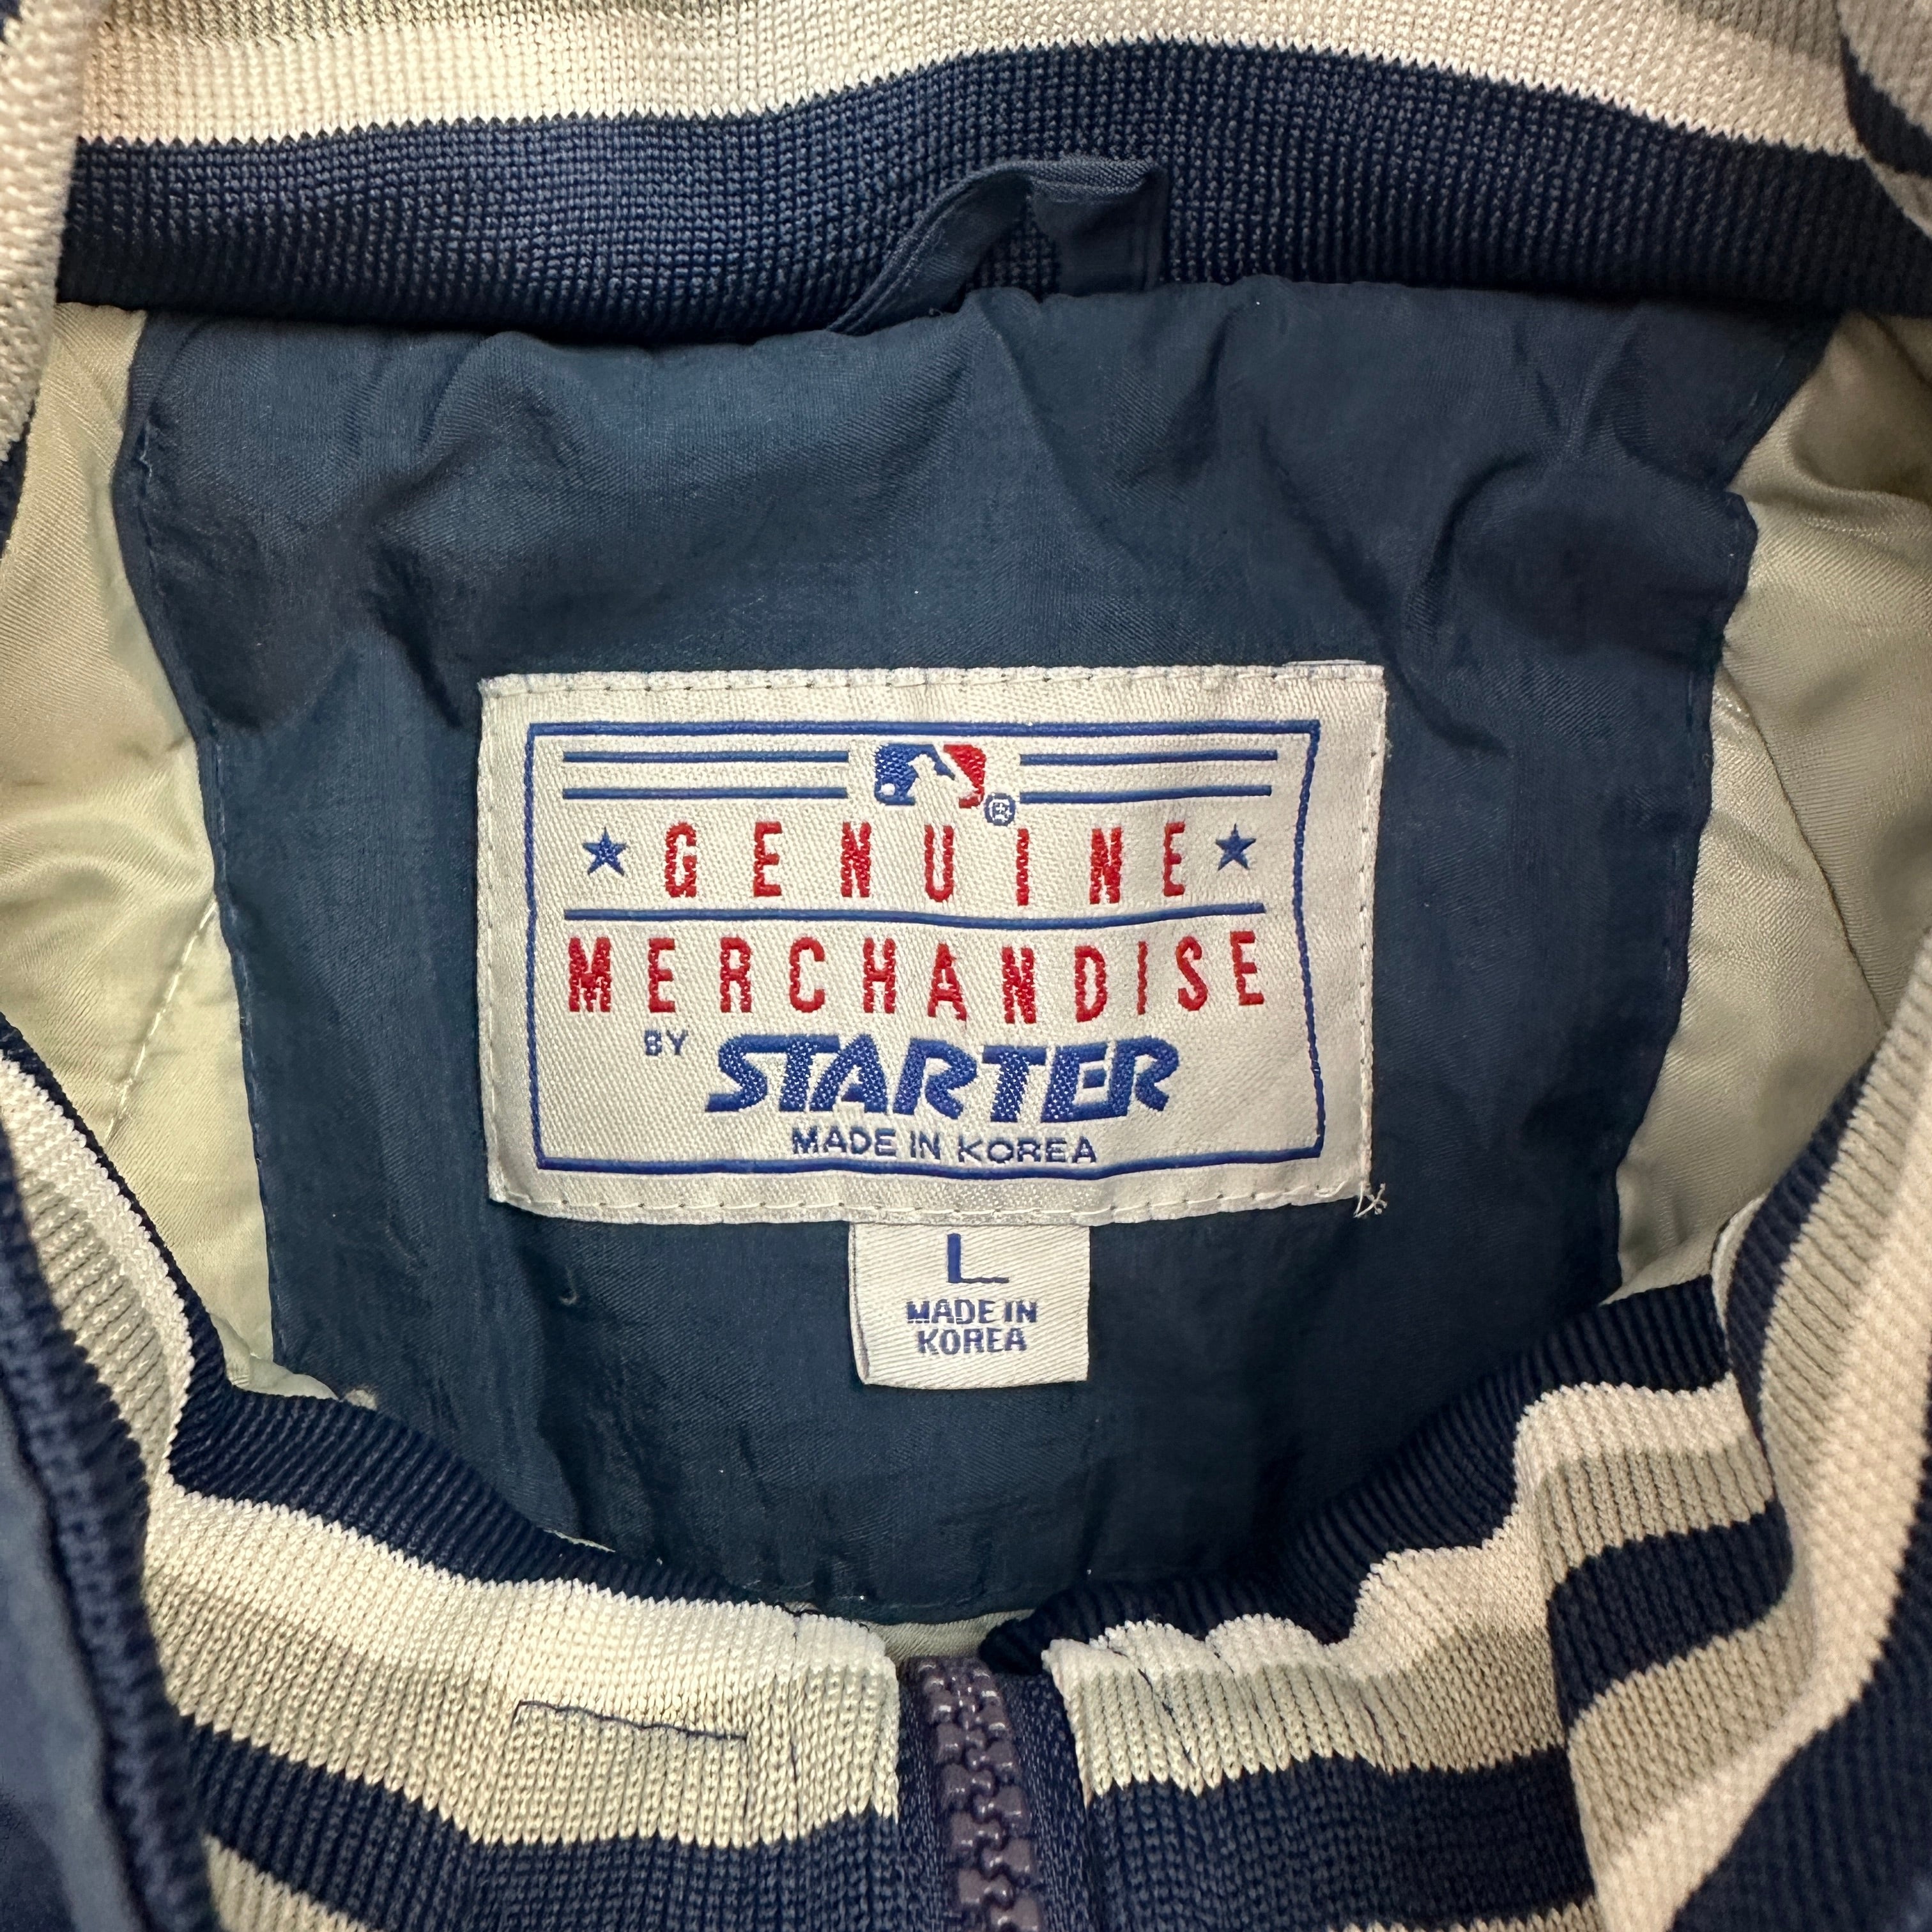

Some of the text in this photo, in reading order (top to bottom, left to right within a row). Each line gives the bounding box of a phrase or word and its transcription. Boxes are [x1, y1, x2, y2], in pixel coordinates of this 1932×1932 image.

[664, 822, 1186, 906] GENUINE
[567, 930, 1266, 1025] MERCHANDISE
[643, 1029, 1181, 1123] BY STARTER
[791, 1127, 1098, 1164] MADE IN KOREA
[946, 1232, 1009, 1284] L
[906, 1299, 1038, 1325] MADE IN
[917, 1328, 1028, 1355] KOREA
